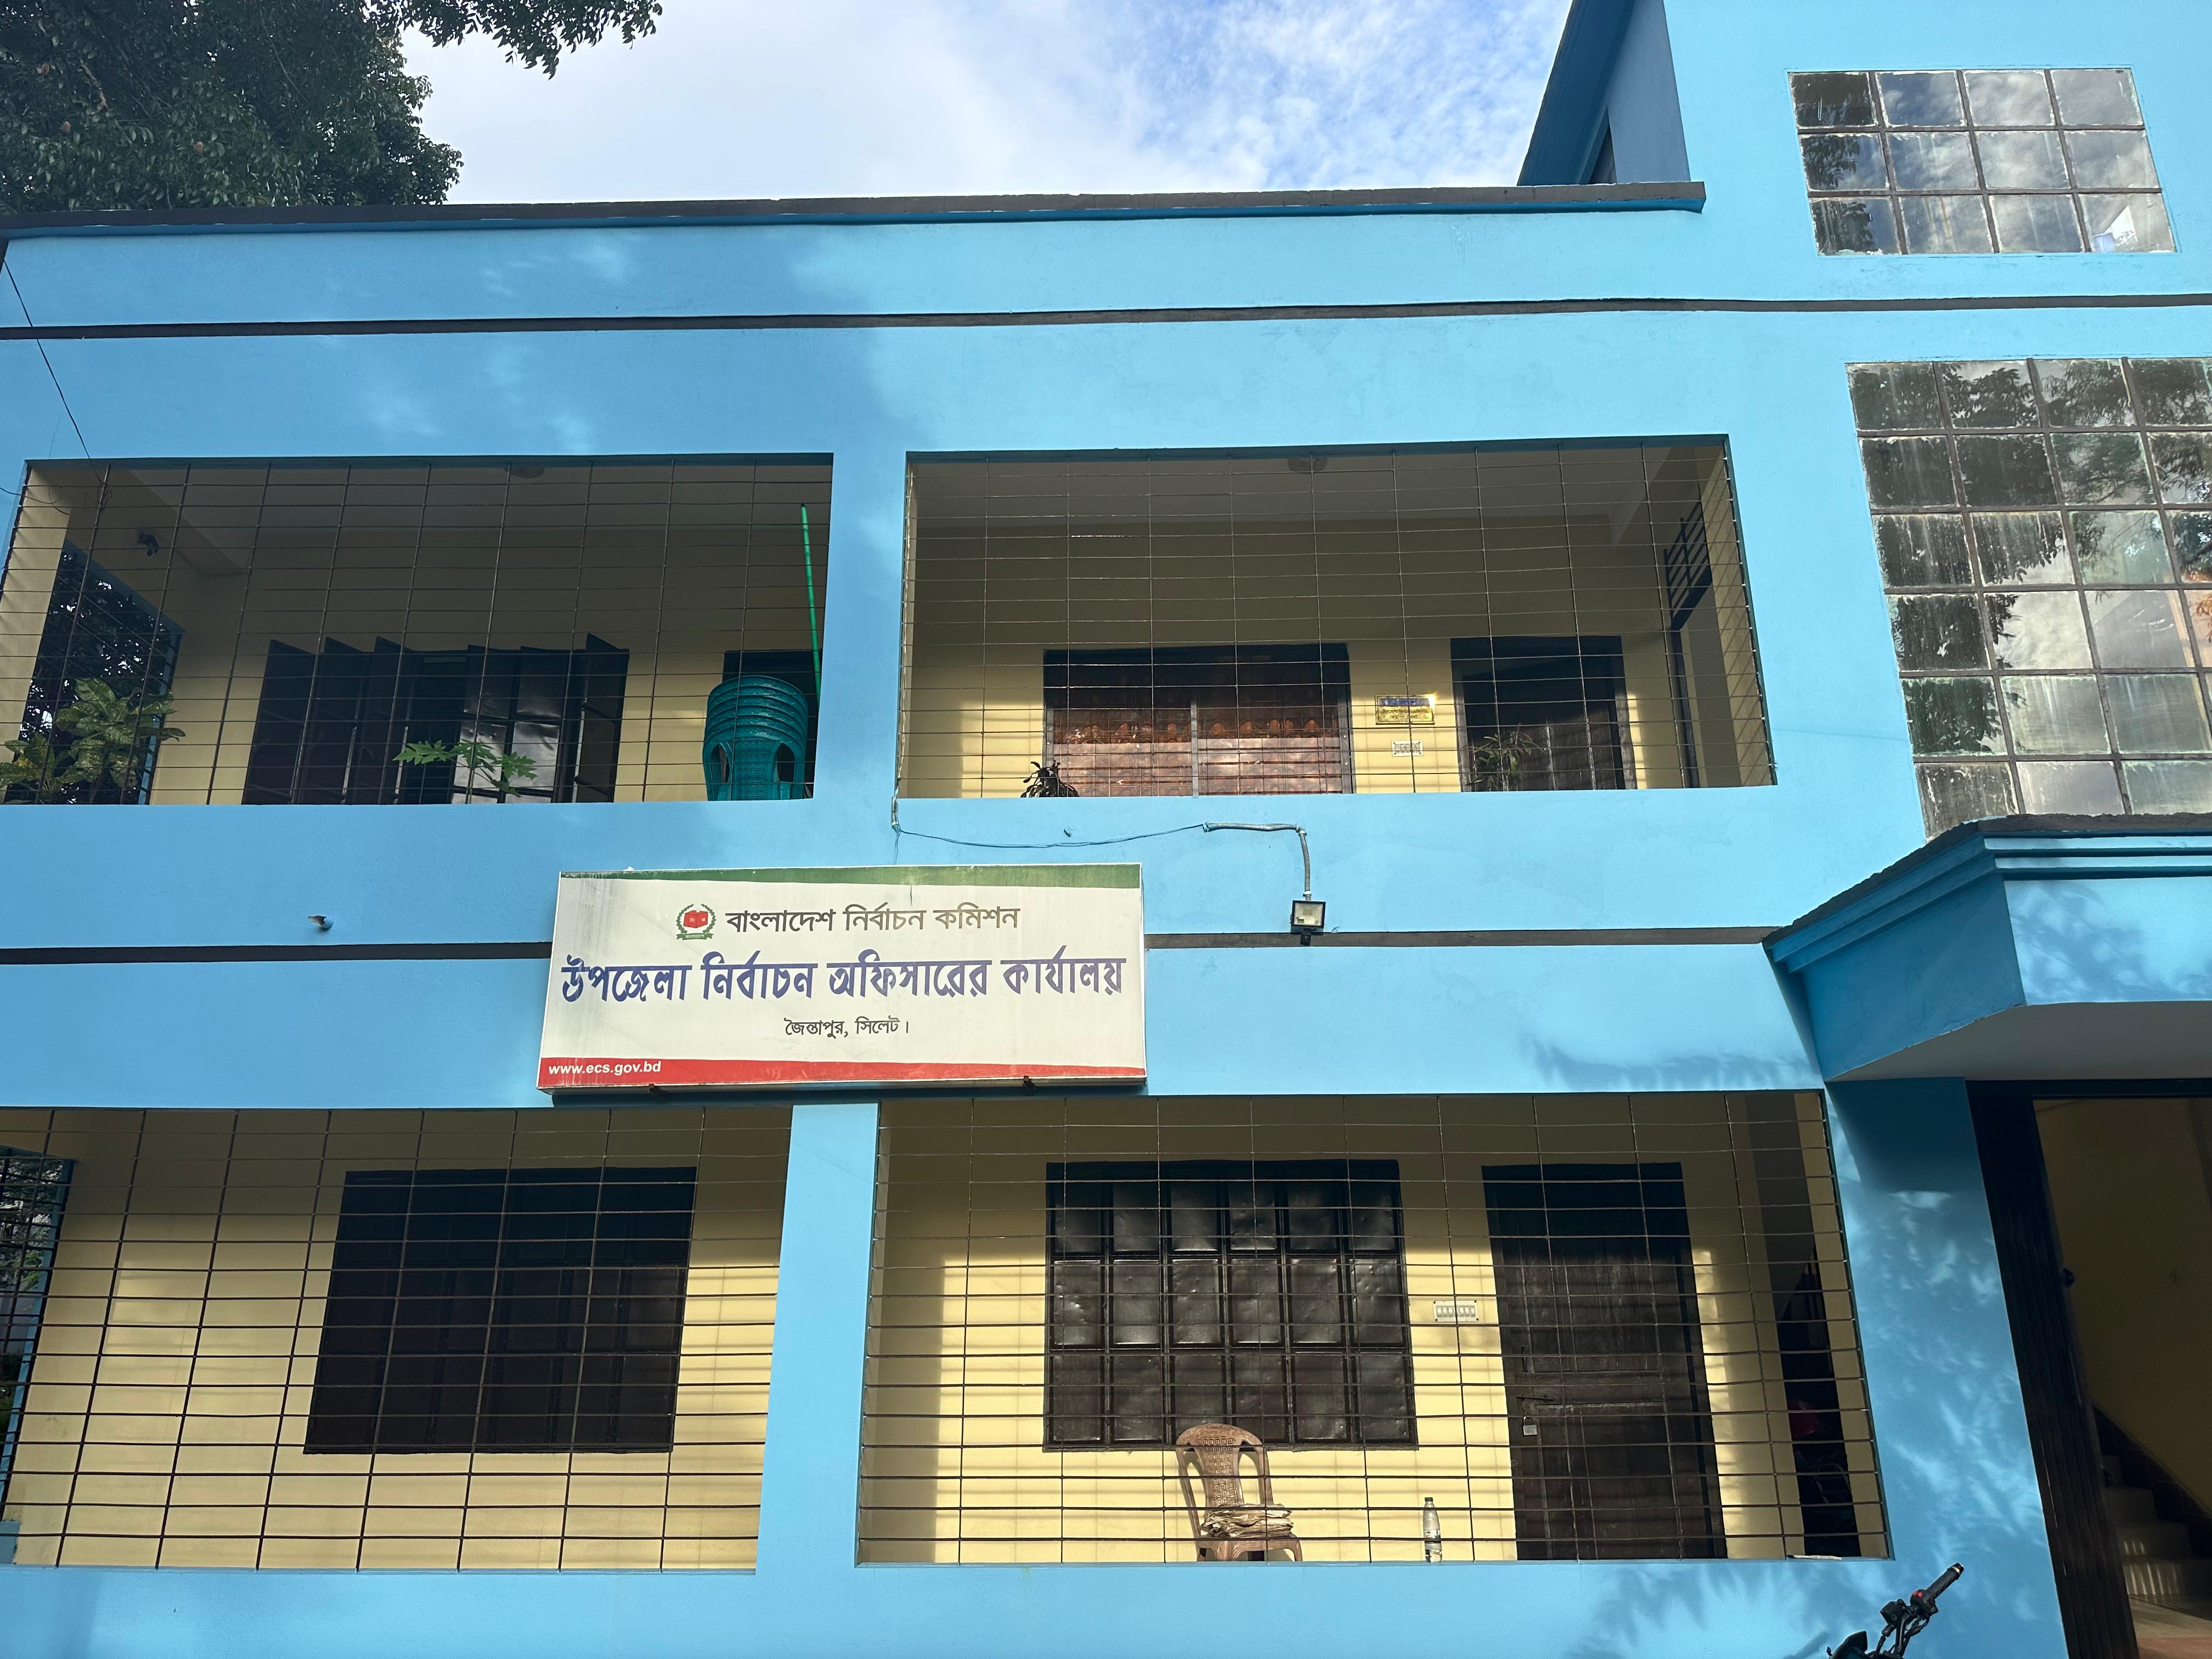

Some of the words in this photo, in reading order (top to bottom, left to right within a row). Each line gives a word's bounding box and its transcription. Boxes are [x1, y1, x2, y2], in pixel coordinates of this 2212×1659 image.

[725, 909, 837, 933] বাংলাদেশ
[842, 901, 927, 931] নির্বাচন
[933, 901, 1021, 929] কমিশন
[561, 953, 693, 1002] উপজেলা
[700, 950, 819, 1000] নির্বাচন
[826, 949, 992, 998] অফিসারের
[1000, 945, 1127, 996] কার্যালয়
[783, 1017, 849, 1039] জৈন্তাপুর,
[549, 1060, 662, 1076] www.ecs.gov.bd
